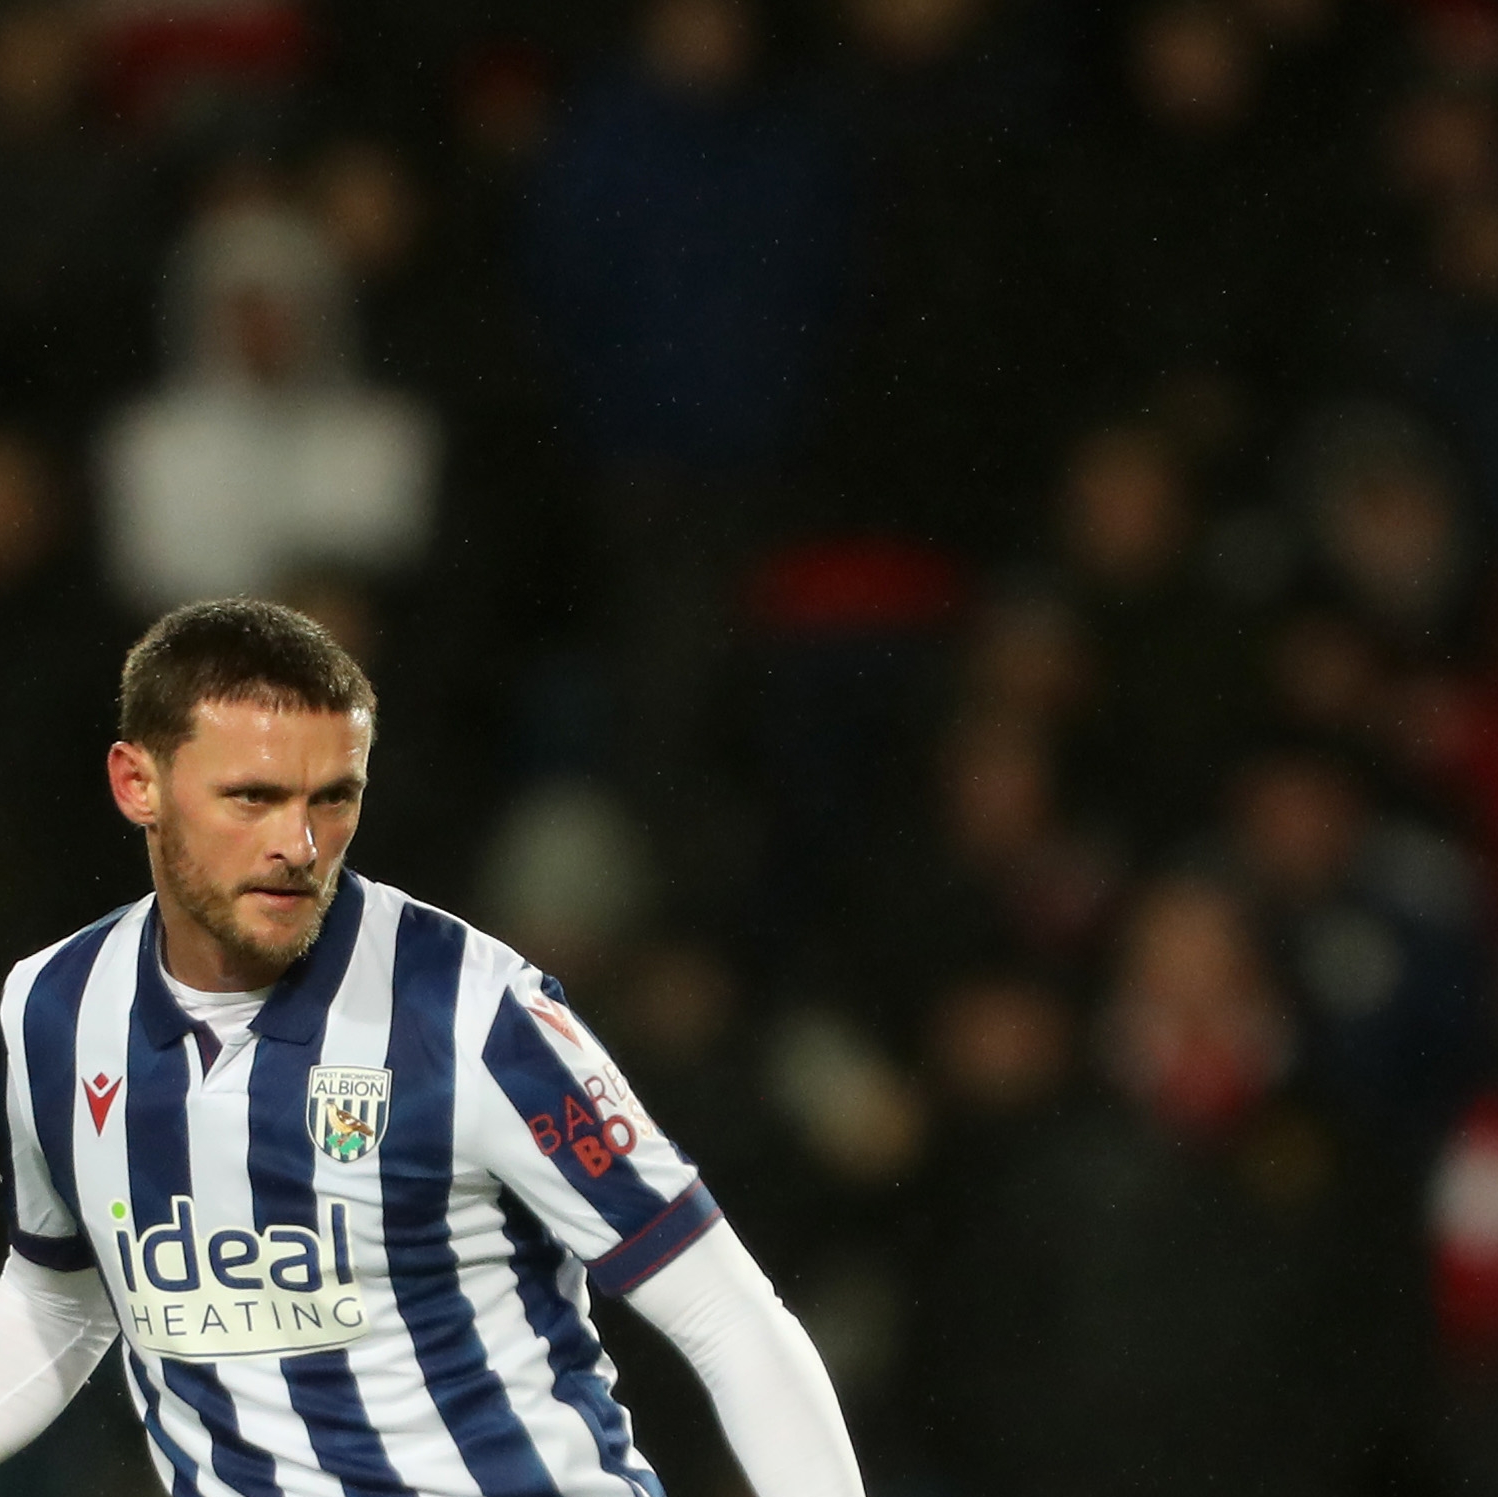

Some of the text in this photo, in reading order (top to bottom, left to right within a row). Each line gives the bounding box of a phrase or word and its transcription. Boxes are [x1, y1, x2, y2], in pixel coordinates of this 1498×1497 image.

[314, 1080, 384, 1097] ALBION
[111, 1200, 354, 1293] ideal
[130, 1296, 364, 1337] HEATING
